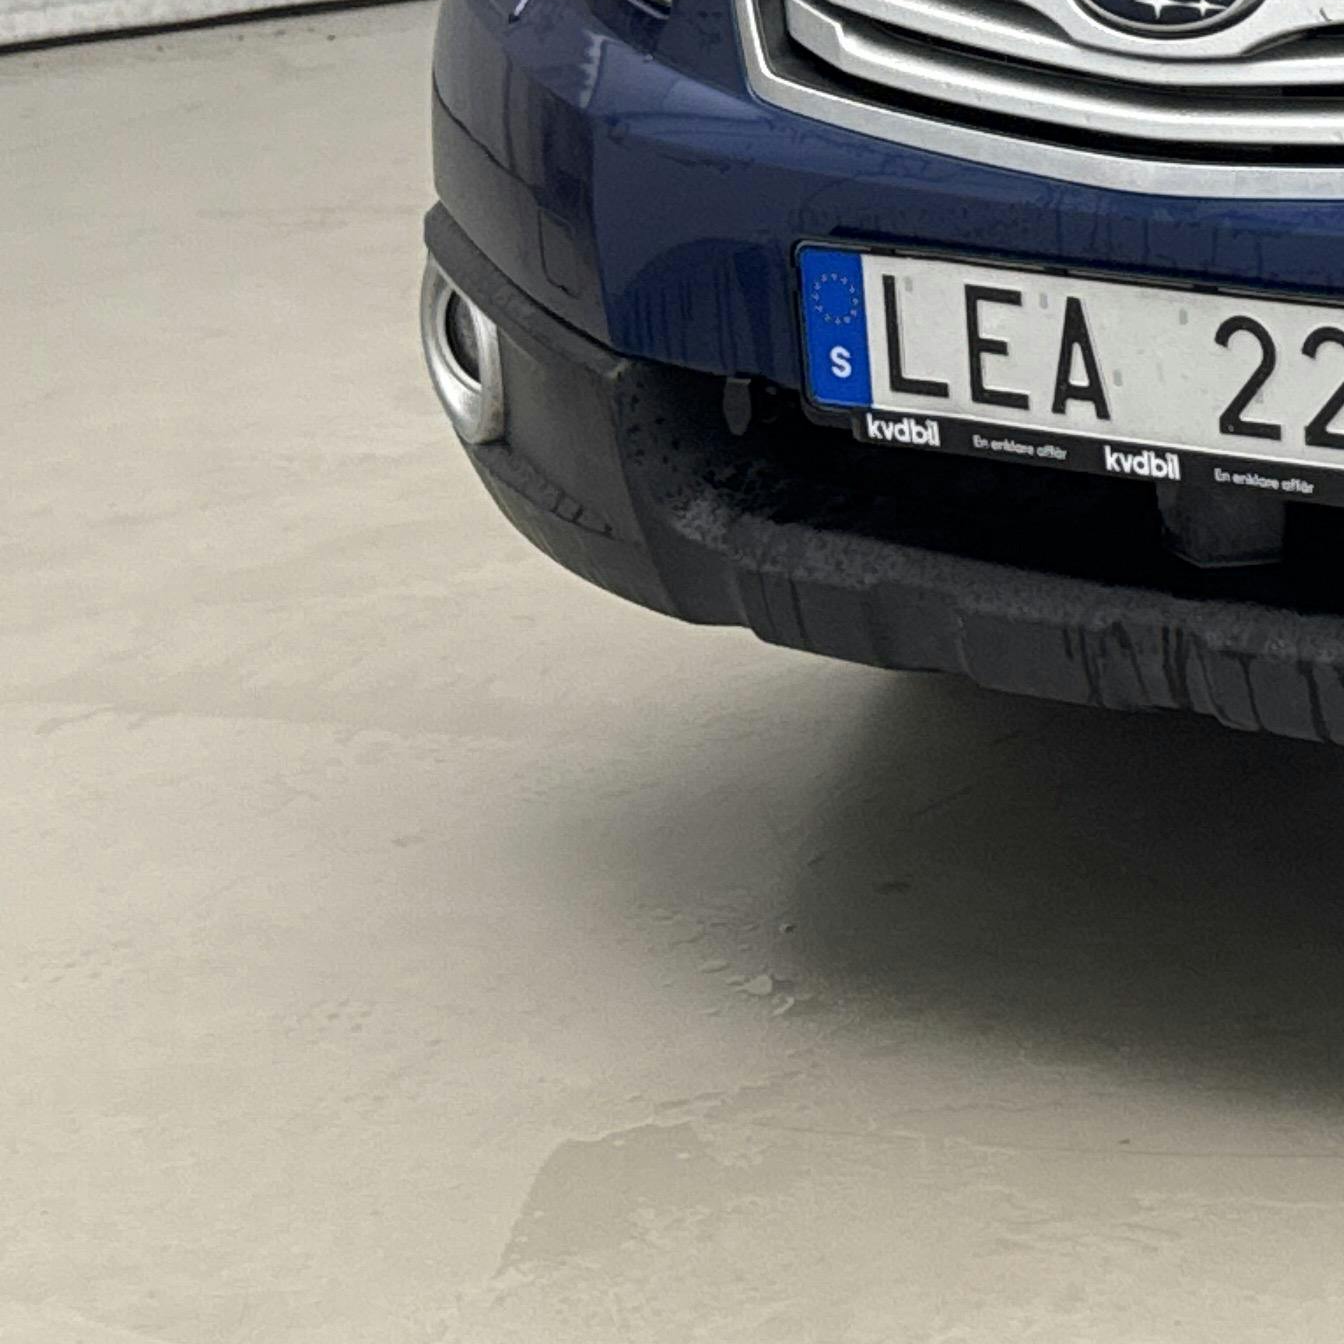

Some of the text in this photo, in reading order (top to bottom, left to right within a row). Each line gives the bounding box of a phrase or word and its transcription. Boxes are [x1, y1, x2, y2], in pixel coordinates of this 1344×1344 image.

[829, 345, 852, 379] S
[882, 274, 1112, 421] LEA
[866, 412, 941, 447] kvdbil
[1104, 445, 1181, 481] kvdbil
